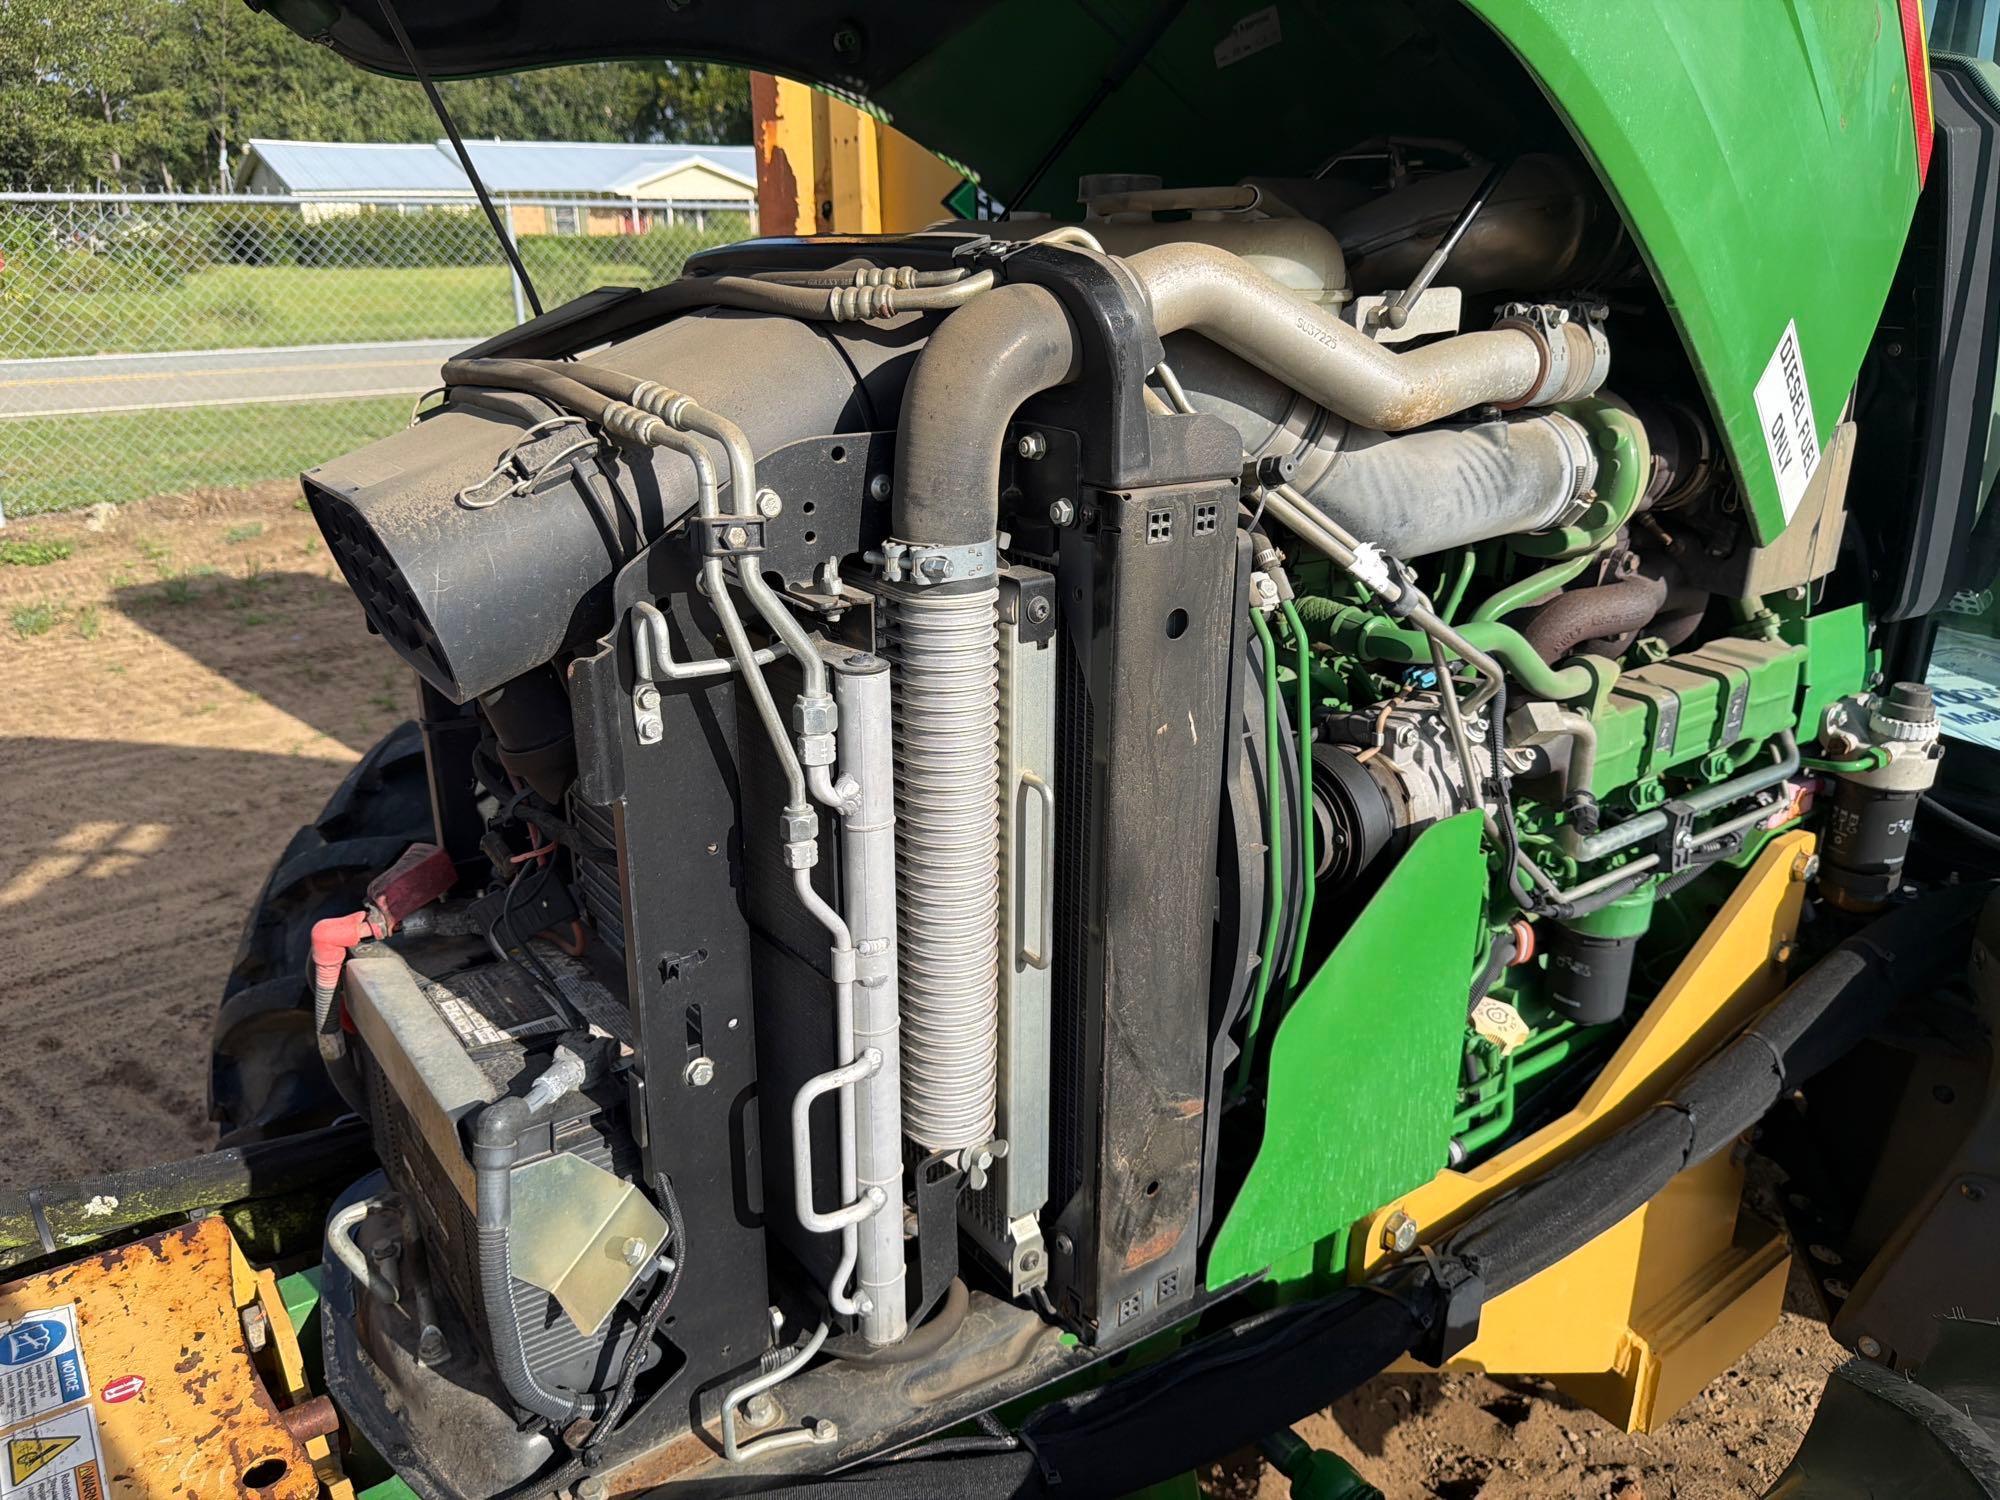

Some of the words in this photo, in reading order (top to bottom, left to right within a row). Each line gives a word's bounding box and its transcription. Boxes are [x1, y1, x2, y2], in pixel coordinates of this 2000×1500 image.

[1296, 316, 1338, 350] SU37225
[1780, 333, 1806, 428] DIESEL
[1797, 417, 1816, 480] FUEL
[1771, 412, 1793, 475] ONLY
[62, 1359, 80, 1392] NOTICE
